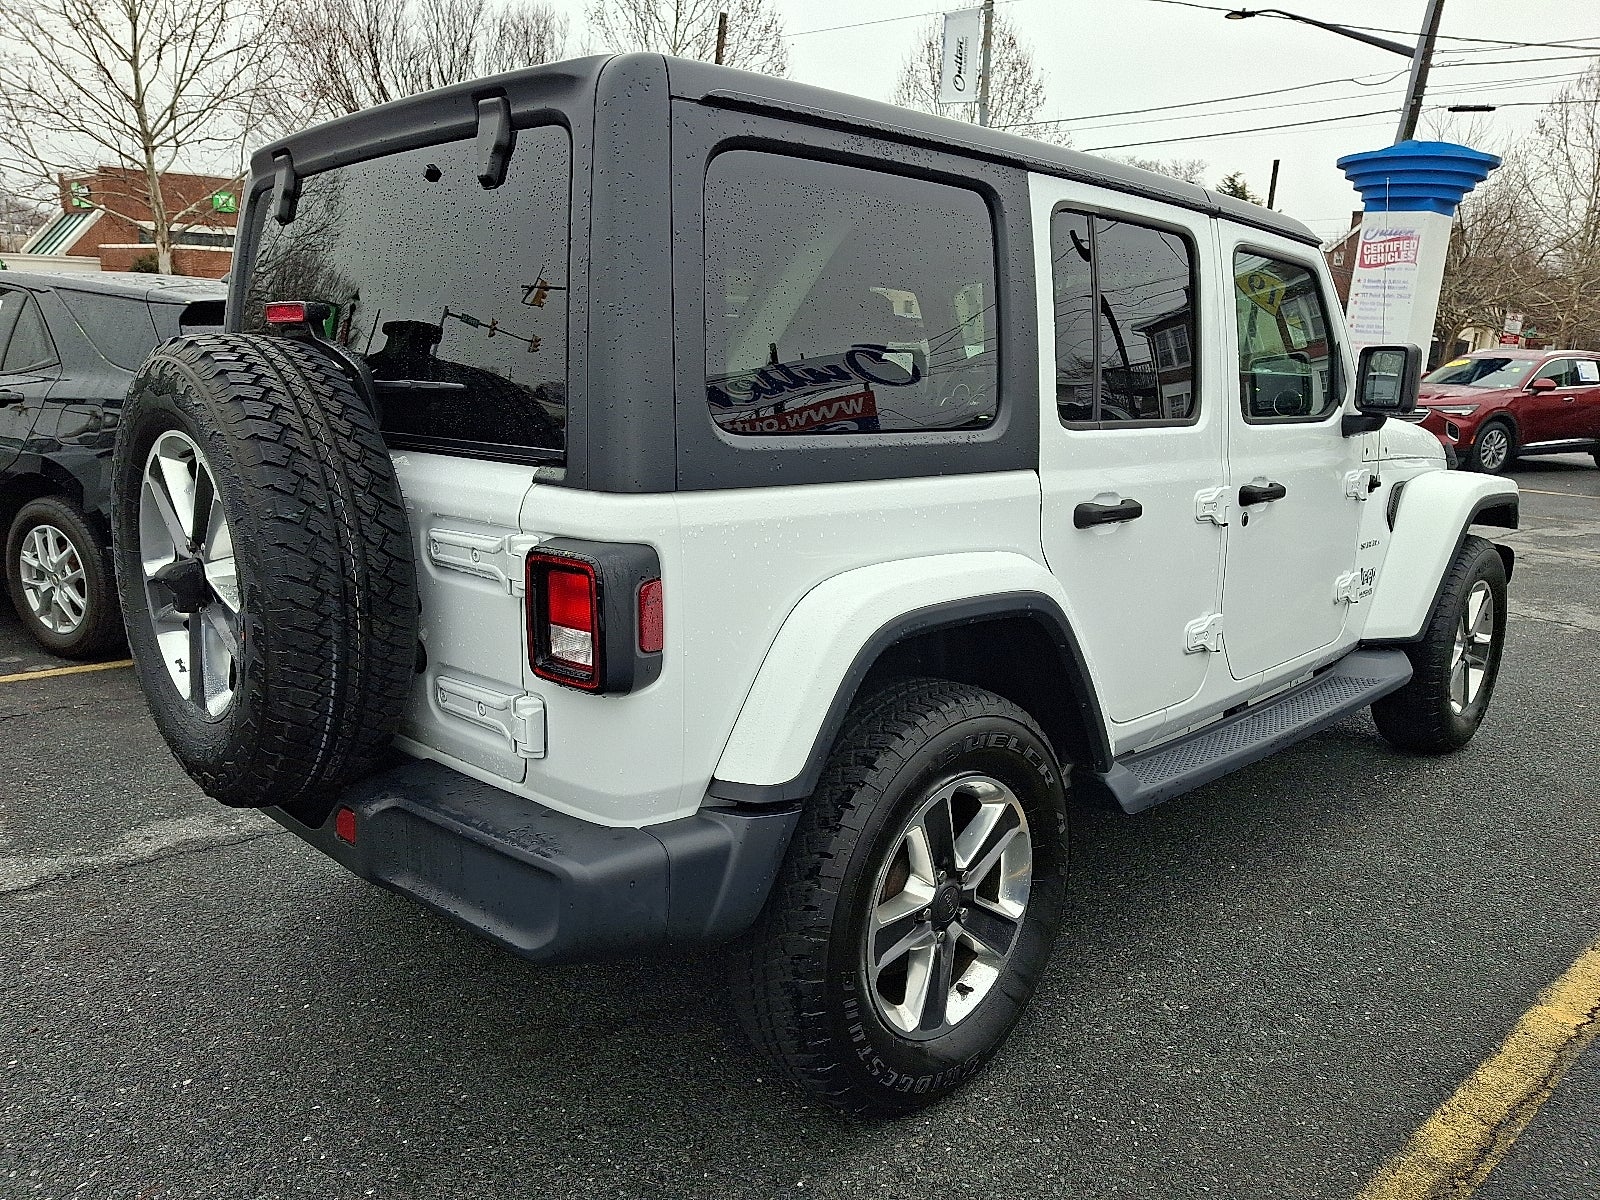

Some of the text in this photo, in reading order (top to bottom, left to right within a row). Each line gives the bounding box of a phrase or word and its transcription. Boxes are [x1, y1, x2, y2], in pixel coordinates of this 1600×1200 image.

[952, 37, 966, 92] Outten
[1363, 239, 1418, 255] CERTIFIED
[1363, 250, 1416, 265] VEHICLES
